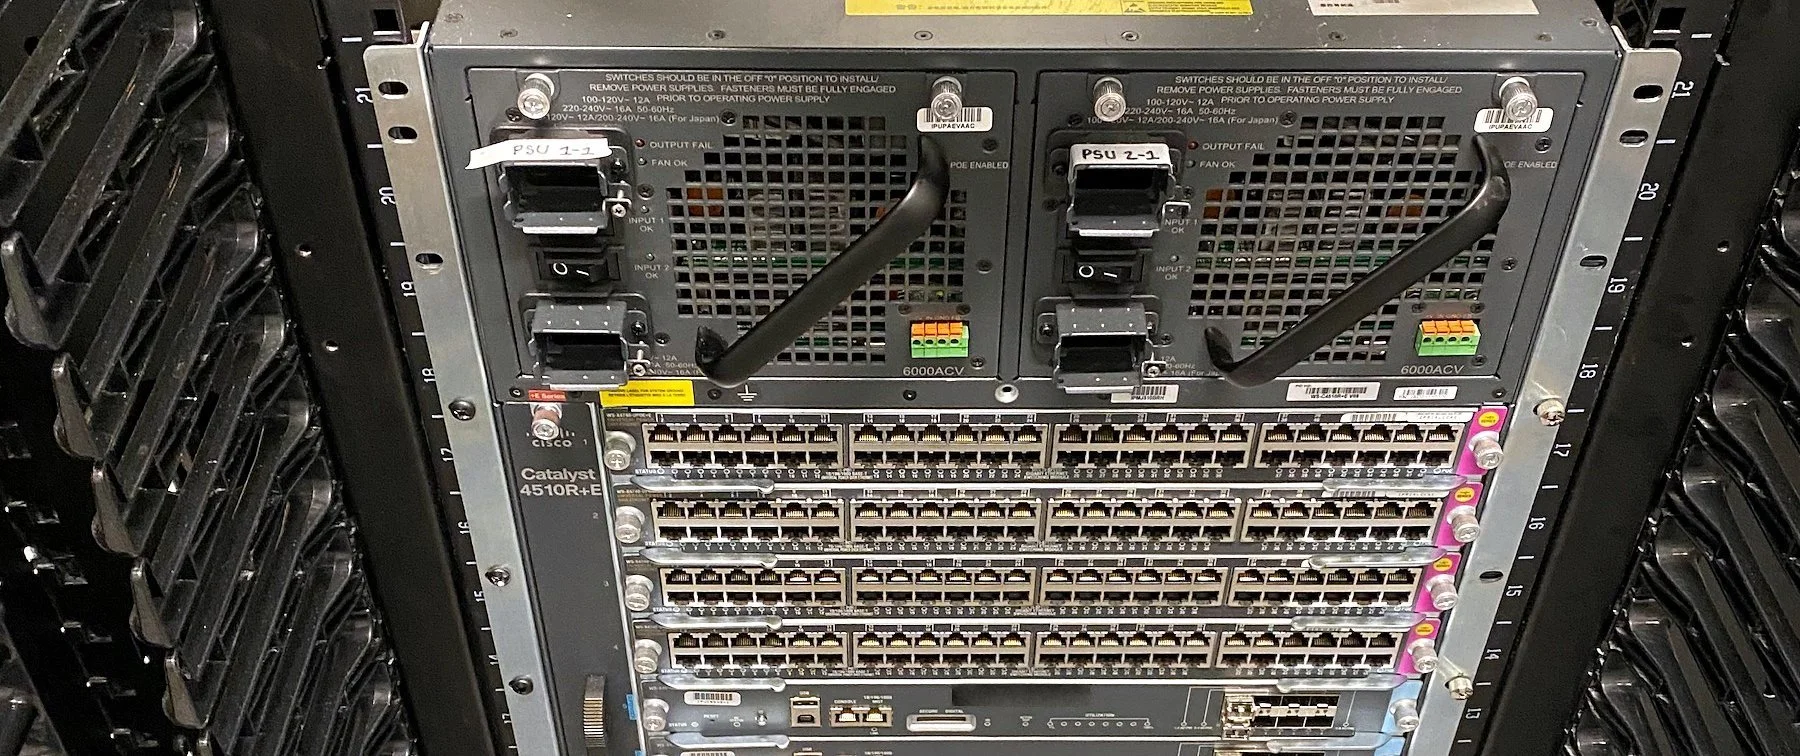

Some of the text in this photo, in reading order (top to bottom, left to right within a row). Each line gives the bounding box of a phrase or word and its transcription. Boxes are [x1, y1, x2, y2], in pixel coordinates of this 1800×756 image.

[605, 73, 654, 82] SWITCHES
[656, 74, 695, 82] SHOULD
[696, 74, 707, 82] BE
[712, 74, 721, 82] IN
[723, 74, 742, 82] THE
[744, 75, 763, 83] OFF
[779, 75, 823, 83] POSITION
[825, 75, 838, 83] TO
[1175, 75, 1224, 84] SWITCHES
[1225, 75, 1265, 84] SHOULD
[1266, 76, 1279, 84] BE
[1281, 76, 1290, 84] IN
[1292, 76, 1310, 84] THE
[1313, 76, 1331, 84] OFF
[1348, 76, 1393, 84] POSITION
[1394, 76, 1406, 84] TO
[589, 84, 629, 92] REMOVE
[631, 84, 667, 92] POWER
[720, 84, 775, 93] FASTENERS
[777, 85, 803, 93] MUST
[805, 85, 819, 93] BE
[821, 85, 848, 93] FULLY
[850, 85, 896, 94] ENGAGED
[1156, 86, 1196, 94] REMOVE
[1198, 86, 1234, 94] POWER
[1287, 86, 1341, 94] FASTENERS
[1343, 86, 1370, 94] MUST
[1371, 86, 1384, 94] BE
[1386, 86, 1413, 94] FULLY
[1415, 86, 1462, 94] ENGAGED
[1671, 80, 1694, 98] 21
[355, 87, 373, 104] 21
[656, 94, 831, 103] PRIOR TO OPERATING POWER SUPPLY
[1220, 96, 1395, 104] PRIOR TO OPERATING POWER SUPPLY
[1197, 98, 1214, 106] 12A
[615, 105, 632, 113] 16A
[1176, 107, 1193, 115] 16A
[1198, 107, 1236, 115] 50-60Hz
[648, 114, 666, 122] 16A
[668, 114, 686, 123] (For
[691, 115, 720, 124] Japan)
[1207, 116, 1225, 124] 16A
[1227, 116, 1247, 124] (For
[1248, 116, 1279, 125] Japan)
[649, 141, 712, 149] OUTPUT FAIL
[1202, 142, 1265, 150] OUTPUT FAIL
[513, 145, 595, 156] PSU 1-1
[1081, 148, 1160, 161] PSU 2-1
[651, 159, 688, 167] FAN OK
[950, 161, 1009, 169] POE ENABLED
[1199, 160, 1236, 168] FAN OK
[1503, 161, 1558, 169] OE ENABLED
[1637, 182, 1659, 200] 20
[628, 217, 657, 225] INPUT
[1164, 218, 1191, 226] NPUT
[1171, 226, 1185, 234] OK
[1156, 265, 1192, 273] INPUT 2
[645, 271, 659, 279] OK
[1607, 277, 1628, 294] 19
[902, 366, 965, 376] 6000ACV
[1400, 365, 1465, 375] 6000ACV
[1578, 363, 1598, 379] 18
[1553, 443, 1572, 458] 17
[520, 467, 597, 482] Catalyst
[519, 484, 602, 496] 4510R+E
[1528, 516, 1546, 530] 16
[1505, 585, 1523, 597] 15
[1484, 649, 1501, 660] 14
[1465, 707, 1482, 719] 13
